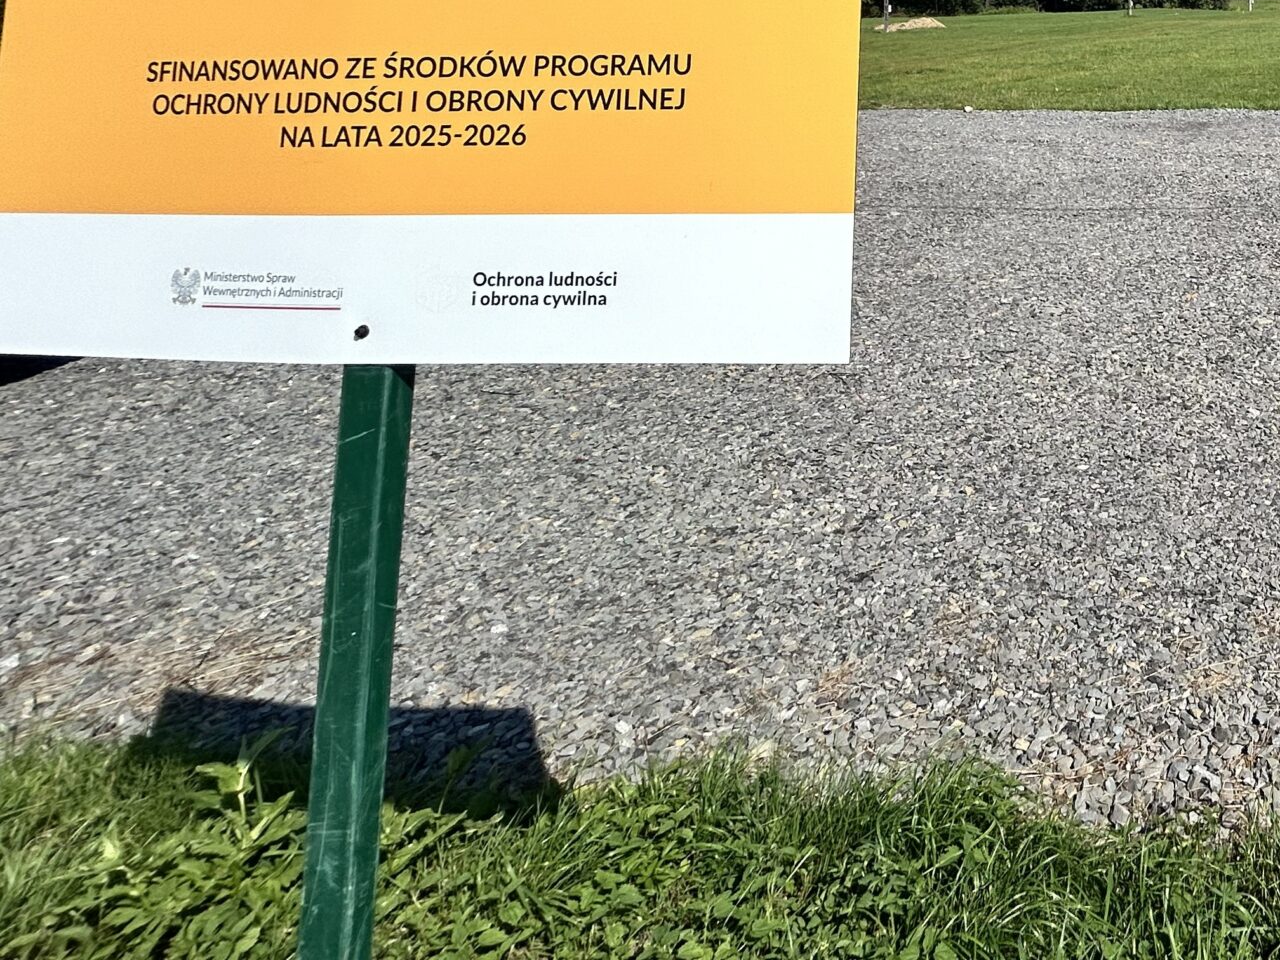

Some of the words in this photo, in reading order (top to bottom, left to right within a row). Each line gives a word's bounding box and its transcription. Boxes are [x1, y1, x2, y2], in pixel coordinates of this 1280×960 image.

[146, 57, 339, 83] SFINANSOWANO
[344, 57, 377, 80] ZE
[382, 49, 527, 79] ŚRODKÓW
[533, 53, 692, 77] PROGRAMU
[152, 92, 270, 116] OCHRONY
[273, 85, 403, 114] LUDNOŚCI
[411, 90, 418, 113] I
[425, 89, 546, 113] OBRONY
[550, 87, 686, 112] CYWILNEJ
[279, 126, 315, 148] NA
[321, 125, 383, 148] LATA
[388, 123, 527, 147] 2025-2026
[203, 271, 265, 283] Ministerstwo
[266, 272, 295, 286] Spraw
[472, 271, 545, 287] Ochrona
[548, 270, 618, 287] ludności
[202, 284, 272, 300] Wewnętrznych
[272, 286, 278, 298] i
[278, 286, 344, 300] Administracji
[471, 290, 477, 306] i
[479, 290, 539, 306] obrona
[542, 290, 607, 310] cywilna
